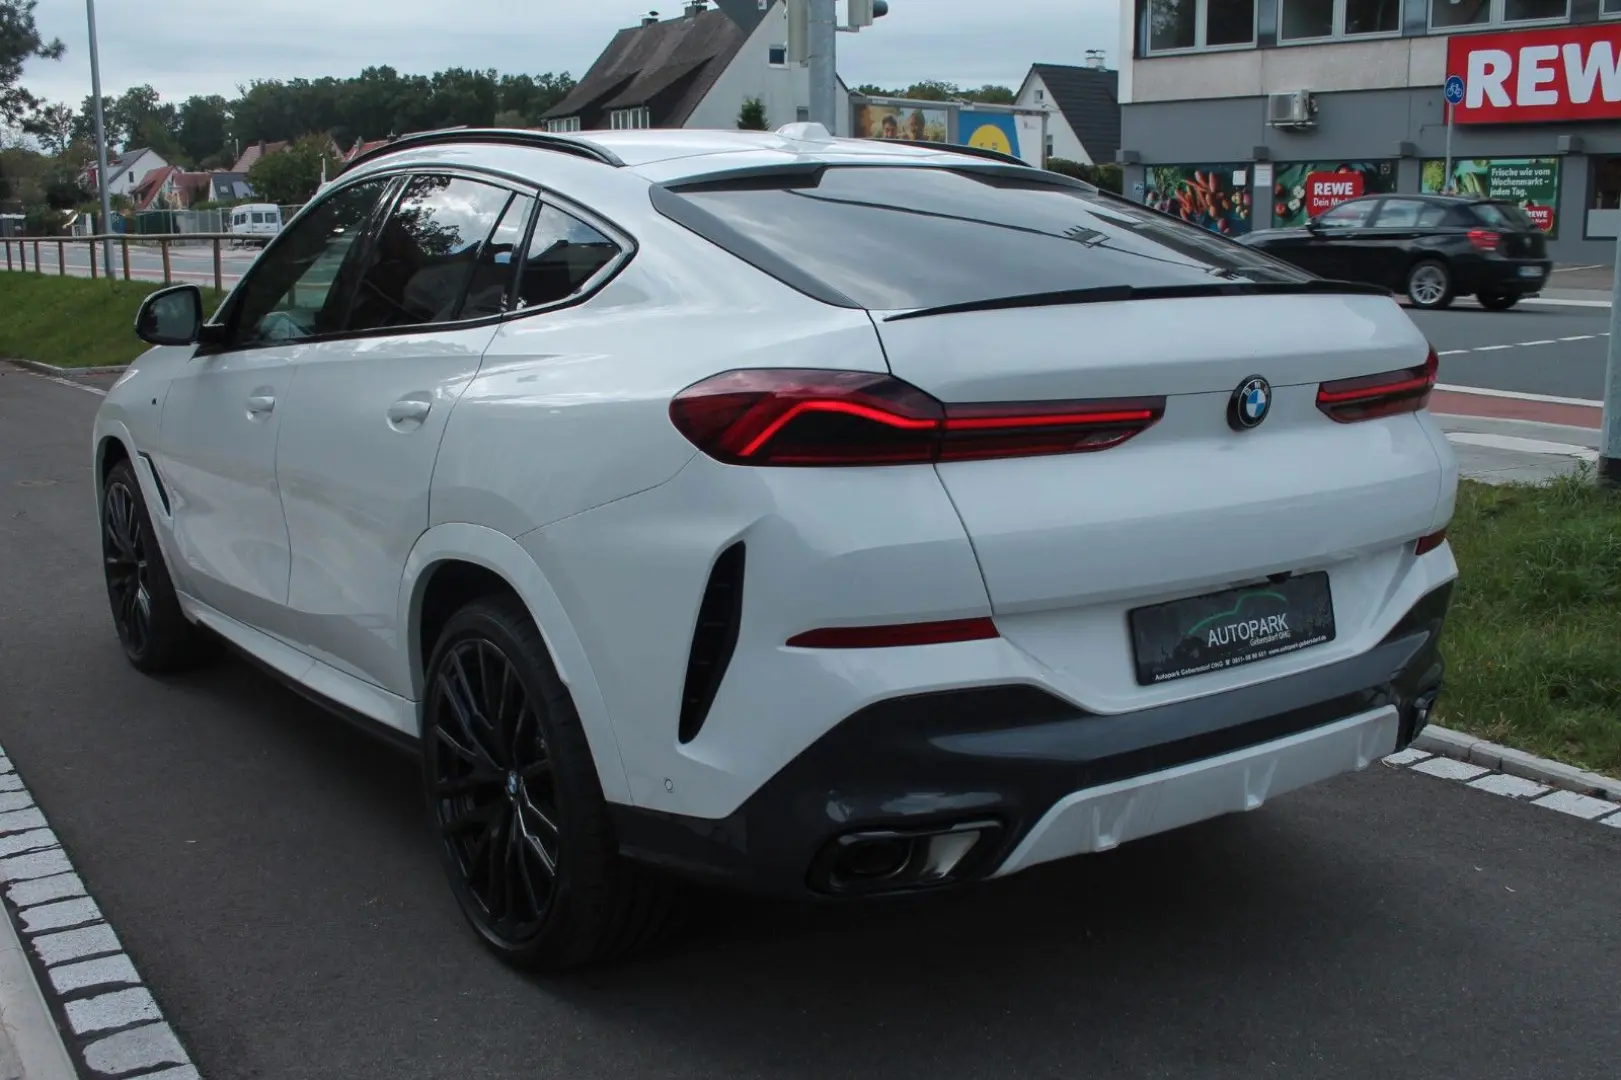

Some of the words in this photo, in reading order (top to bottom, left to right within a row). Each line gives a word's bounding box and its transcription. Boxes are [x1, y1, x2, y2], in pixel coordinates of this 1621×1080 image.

[1491, 168, 1518, 176] Frische
[1519, 168, 1533, 176] wie
[1491, 177, 1543, 186] Wochenmarkt
[1314, 182, 1353, 195] REWE
[1490, 187, 1511, 198] jeden
[1512, 187, 1527, 197] Tag.
[1313, 198, 1329, 207] Dein
[1208, 613, 1289, 648] AUTOPARK
[1250, 632, 1278, 647] Gebersdorf
[1278, 629, 1291, 641] OHG
[1155, 670, 1180, 680] Autopark
